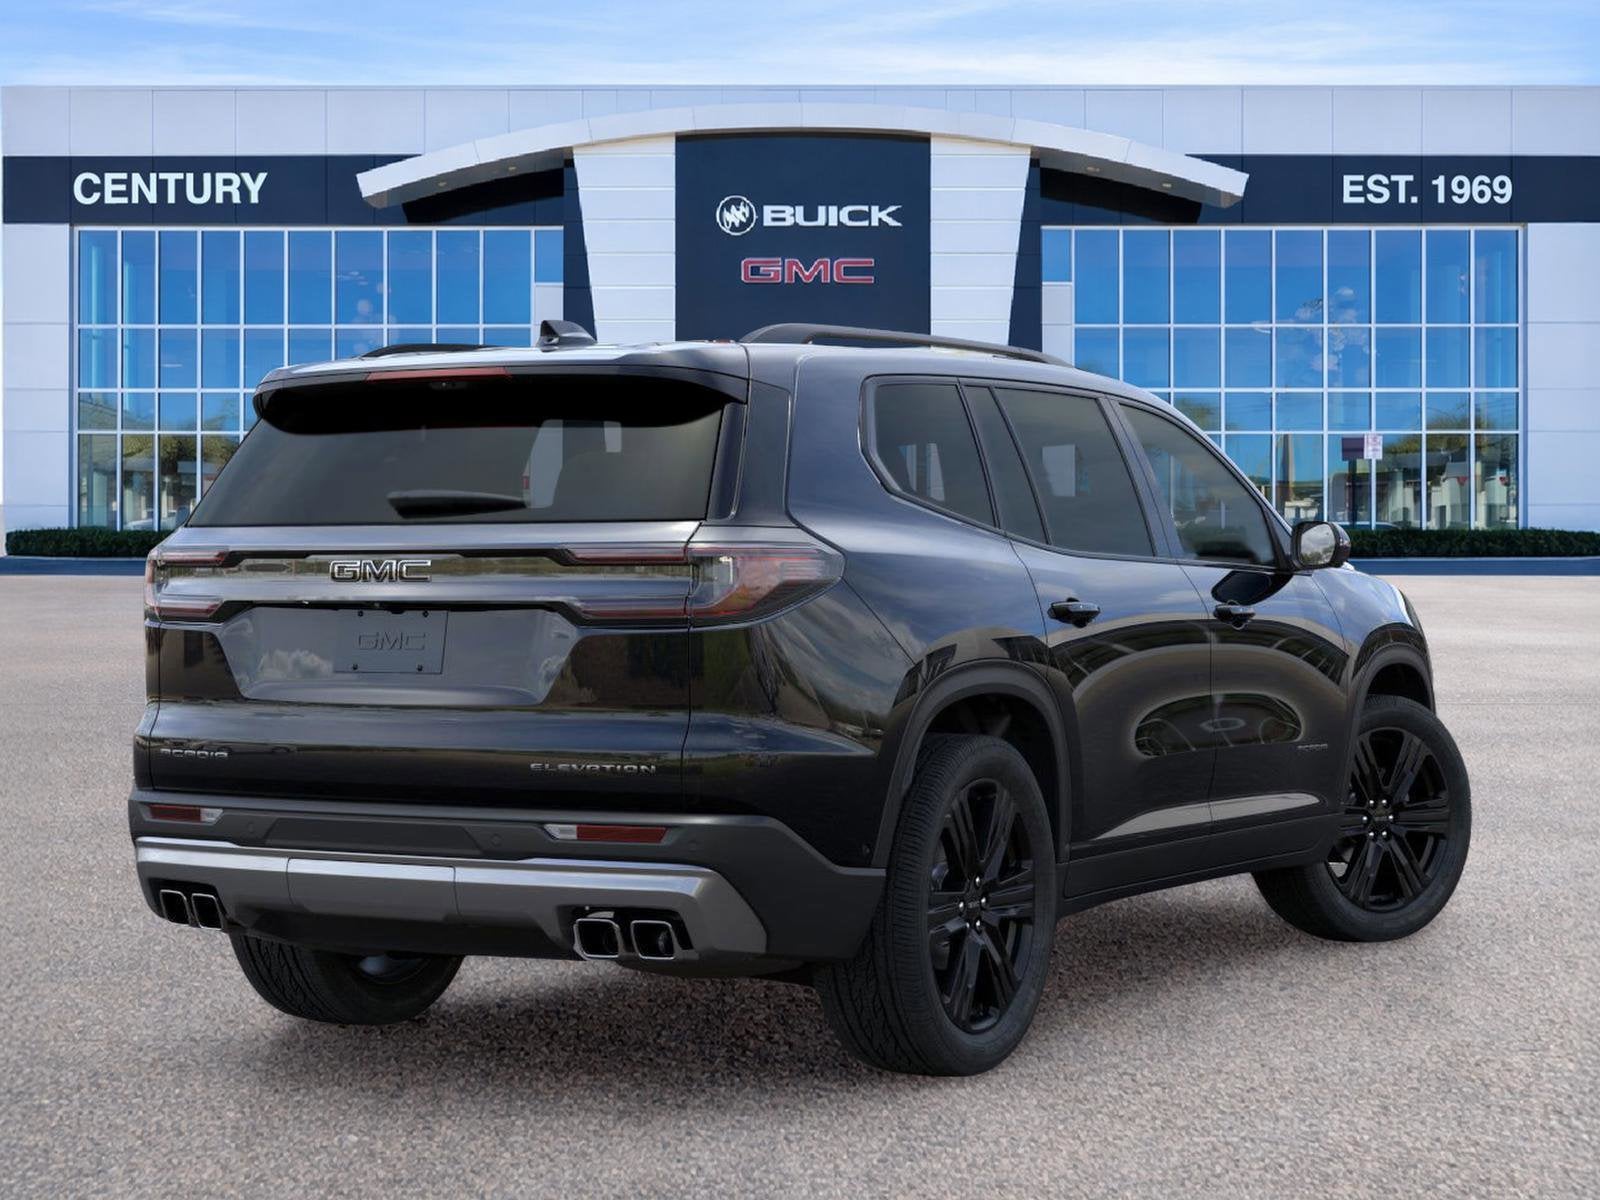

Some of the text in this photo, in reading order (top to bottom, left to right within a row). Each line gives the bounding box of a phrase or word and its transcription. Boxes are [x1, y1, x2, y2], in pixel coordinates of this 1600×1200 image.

[73, 172, 268, 205] CENTURY
[1342, 174, 1513, 204] EST. 1969
[762, 205, 902, 227] BUICK
[741, 257, 875, 284] GMC
[329, 559, 432, 583] GMC
[358, 632, 426, 651] GMC
[529, 762, 657, 775] ELEVATION
